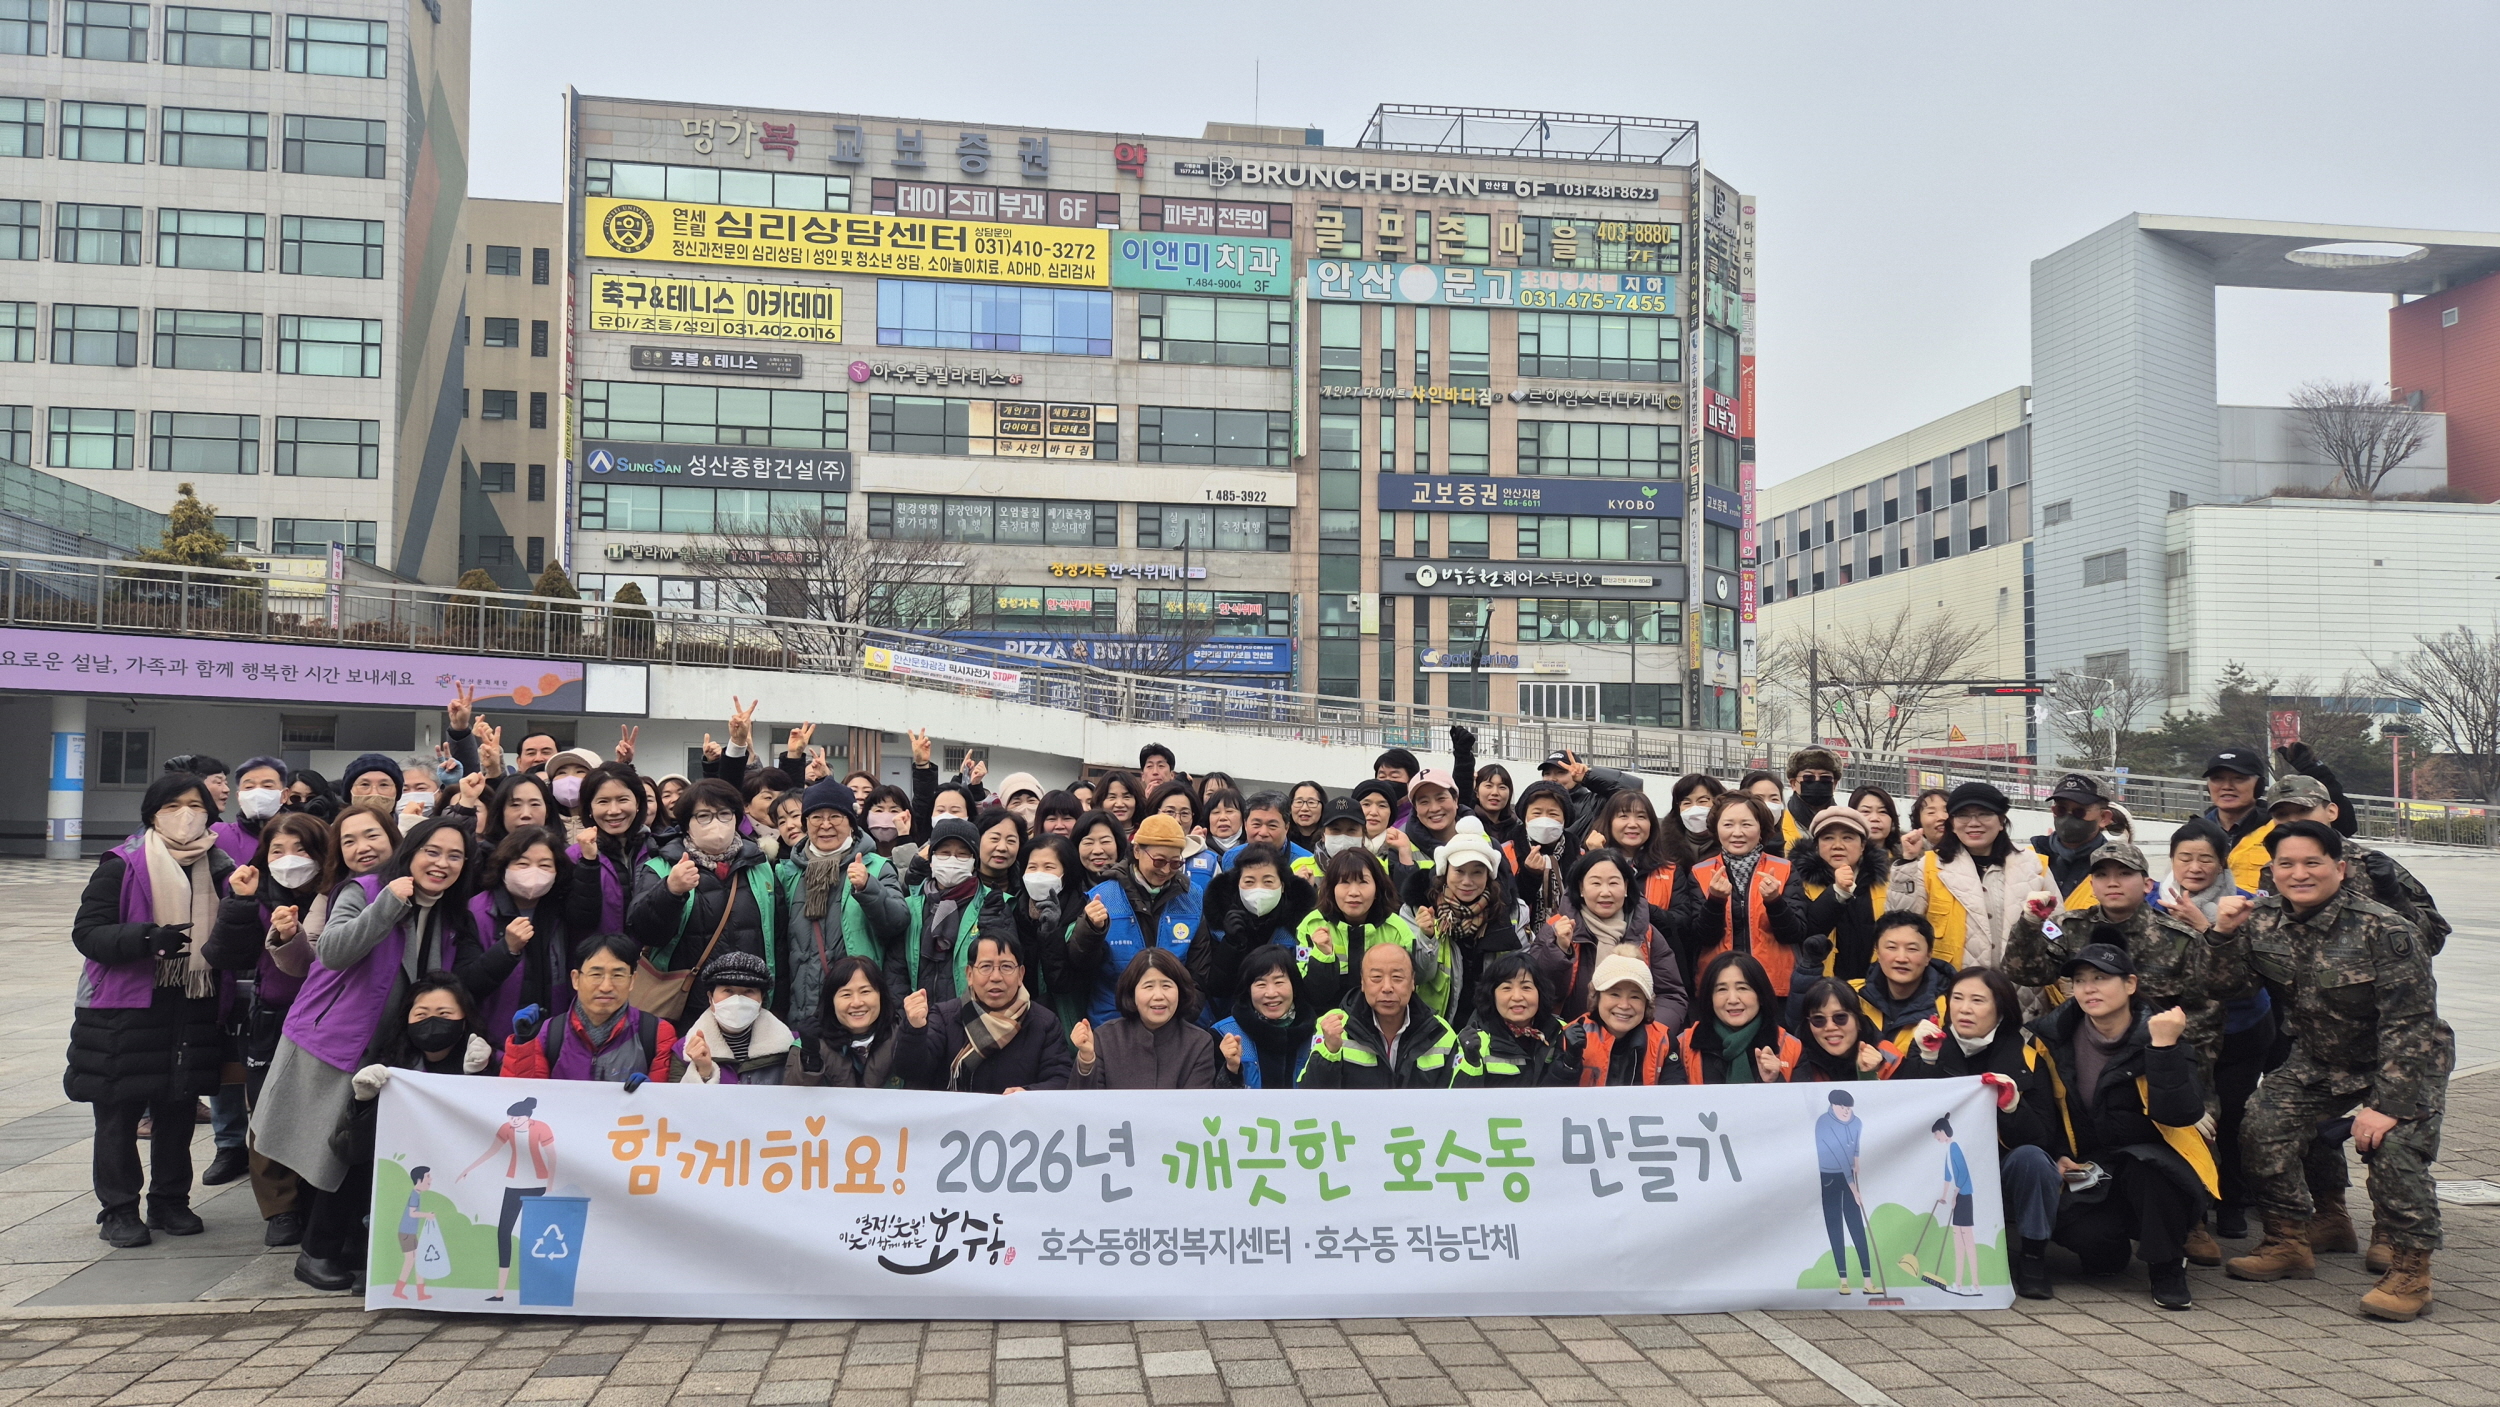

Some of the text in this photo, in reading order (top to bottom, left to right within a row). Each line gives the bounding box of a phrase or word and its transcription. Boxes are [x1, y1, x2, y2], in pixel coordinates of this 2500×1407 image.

[680, 117, 799, 161] 명가복
[828, 124, 1049, 177] 교보증권
[1113, 143, 1148, 179] 약
[1241, 159, 1382, 191] BRUNCH
[1391, 168, 1480, 196] BEAN
[1485, 181, 1508, 190] 안산점
[1515, 177, 1546, 198] 6F
[1564, 184, 1655, 200] 031-481-8623
[898, 185, 1088, 221] 데이즈피부과 6F
[673, 208, 706, 224] 연세
[1164, 204, 1267, 231] 피부과 전문의
[673, 222, 706, 238] 드림
[715, 210, 967, 252] 심리상담센터
[974, 227, 1012, 238] 상담문의
[1597, 221, 1671, 244] 403-8880
[672, 240, 1096, 280] 정신과전문의 심리상담 성인 및 청소년 상담, 소아놀이치료, ADHD, 심리검사
[974, 238, 1096, 260] 031)410-3272
[1629, 250, 1654, 263] 7F
[1743, 221, 1755, 279] 하나투어
[1186, 277, 1270, 293] T.484-9004 3F
[1317, 261, 1514, 305] 안산 문고
[1625, 276, 1663, 293] 지하
[602, 280, 833, 320] 축구&테니스 아카데미
[1520, 290, 1666, 312] 031.475-7455
[723, 322, 836, 340] 031.402.0116
[670, 351, 699, 367] 풋볼
[714, 354, 758, 370] 테니스
[873, 363, 1023, 387] 아우름필라테스 6F
[1364, 387, 1406, 399] 다이어트
[1410, 385, 1492, 407] 샤인바디짐
[1529, 388, 1665, 410] 르하임스터디카페
[1715, 392, 1731, 410] 데이즈
[1003, 422, 1038, 432] 다이어트
[1708, 404, 1737, 435] 피부과
[687, 455, 846, 481] 성산종합건설(주)
[1216, 490, 1267, 502] 485-3922
[1412, 482, 1498, 506] 교보증권
[1502, 487, 1541, 499] 안산지점
[1502, 499, 1541, 508] 484-6011
[896, 502, 938, 515] 환경영향
[946, 504, 992, 517] 공장인허가
[999, 506, 1040, 519] 오염물질
[1608, 499, 1655, 511] KYOBO
[1707, 496, 1728, 514] 교보증권
[999, 520, 1040, 534] 측정대행
[806, 552, 820, 563] 3F
[1051, 562, 1176, 581] 정성가득 한식뷔페
[1743, 581, 1753, 613] 마사지
[1219, 603, 1262, 615] 한식뷔페
[1005, 640, 1068, 659] PIZZA
[0, 651, 415, 687] 요로운 설날, 가족과 함께 행복한 시간 보내세요
[894, 654, 946, 672] 안산문화광장
[949, 663, 990, 679] 픽시자전거
[992, 671, 1017, 683] STOP!!
[1420, 768, 1431, 780] P
[607, 1111, 1742, 1206] 함께해요! 2026년 깨끗한 호수동 만들기
[1038, 1226, 1292, 1266] 호수동행정복지센터
[1407, 1223, 1519, 1263] 직능단체
